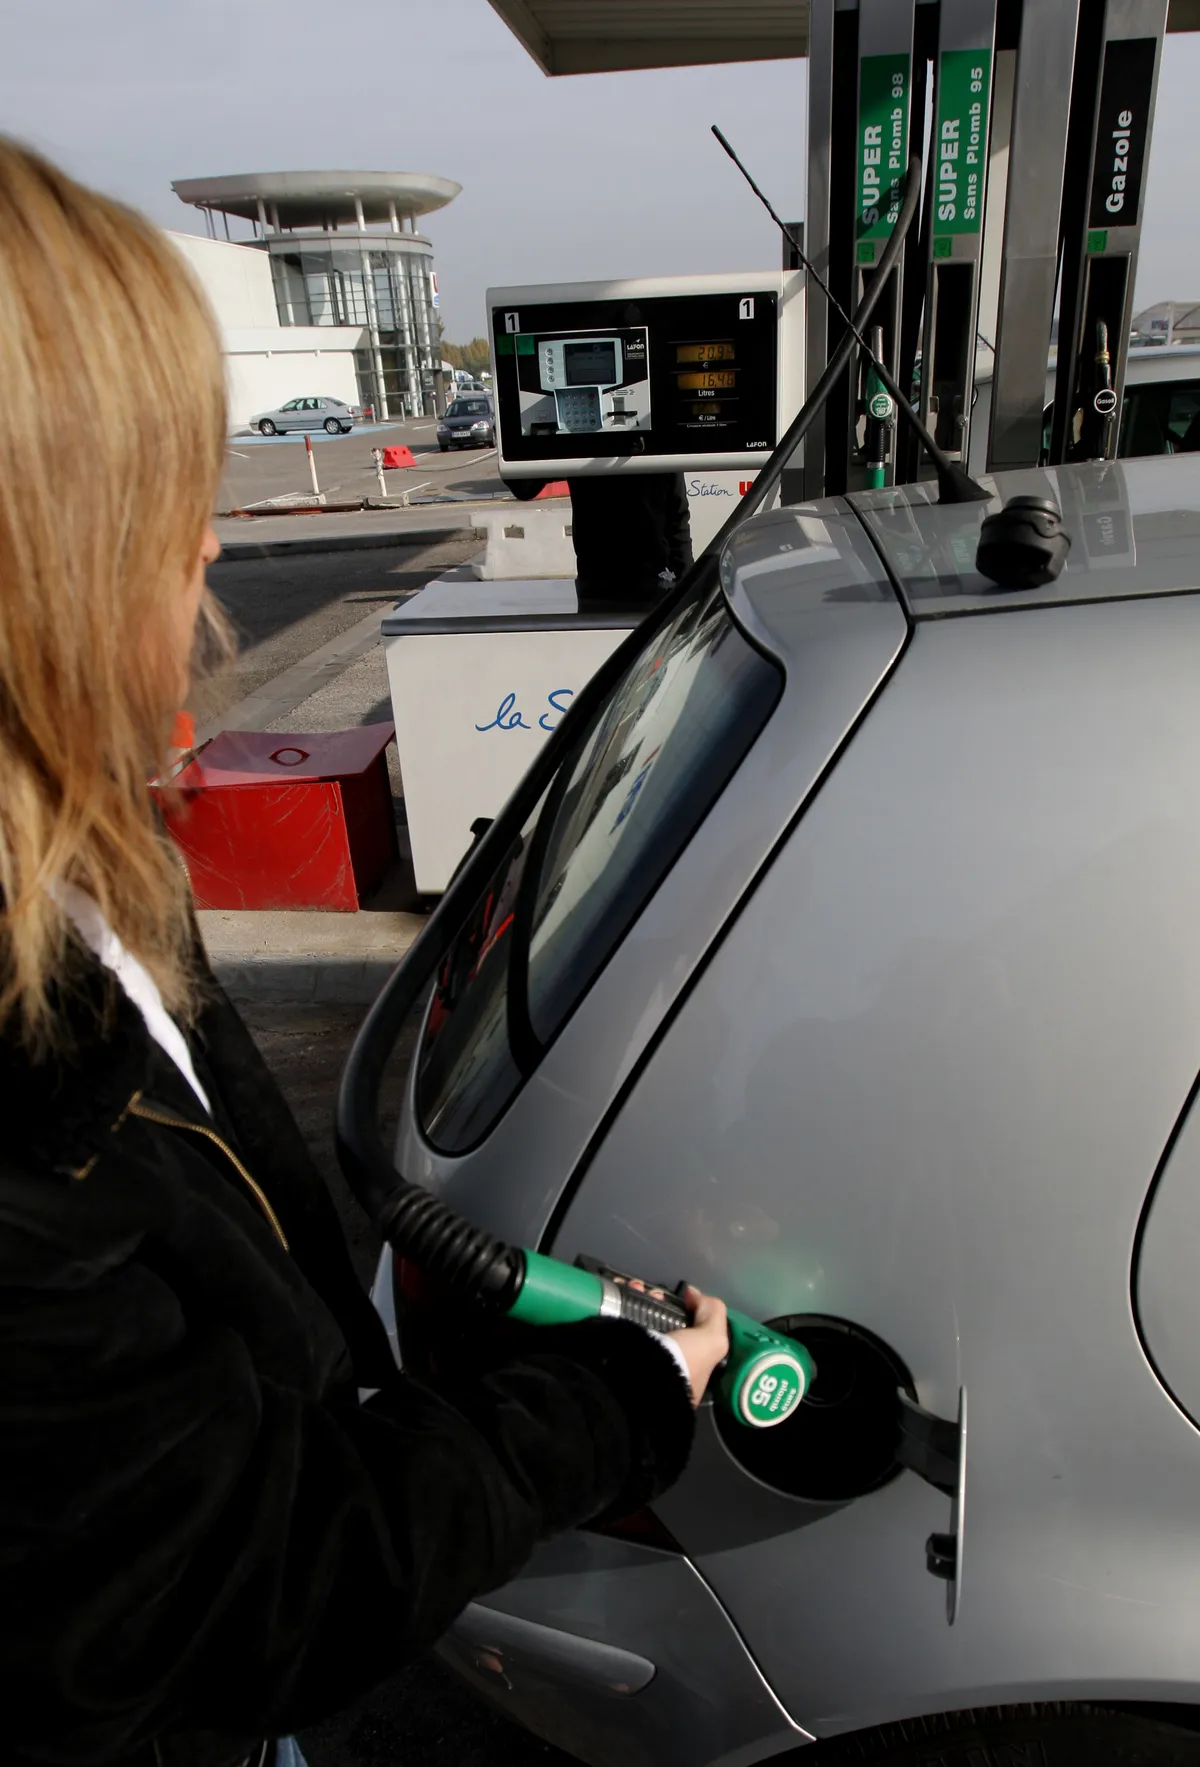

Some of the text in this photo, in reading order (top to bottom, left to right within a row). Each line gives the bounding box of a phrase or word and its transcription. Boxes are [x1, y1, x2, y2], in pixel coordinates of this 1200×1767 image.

[887, 72, 904, 224] Sans Plomb 98
[963, 66, 983, 220] Sans Plomb 95
[862, 124, 882, 226] SUPER
[938, 118, 960, 221] SUPER
[1105, 110, 1133, 213] Gazole
[507, 313, 516, 332] 1
[742, 299, 751, 318] 1
[702, 361, 709, 369] €
[698, 389, 715, 397] Litres
[686, 479, 734, 497] Station
[475, 692, 532, 732] la
[751, 1374, 778, 1406] 95
